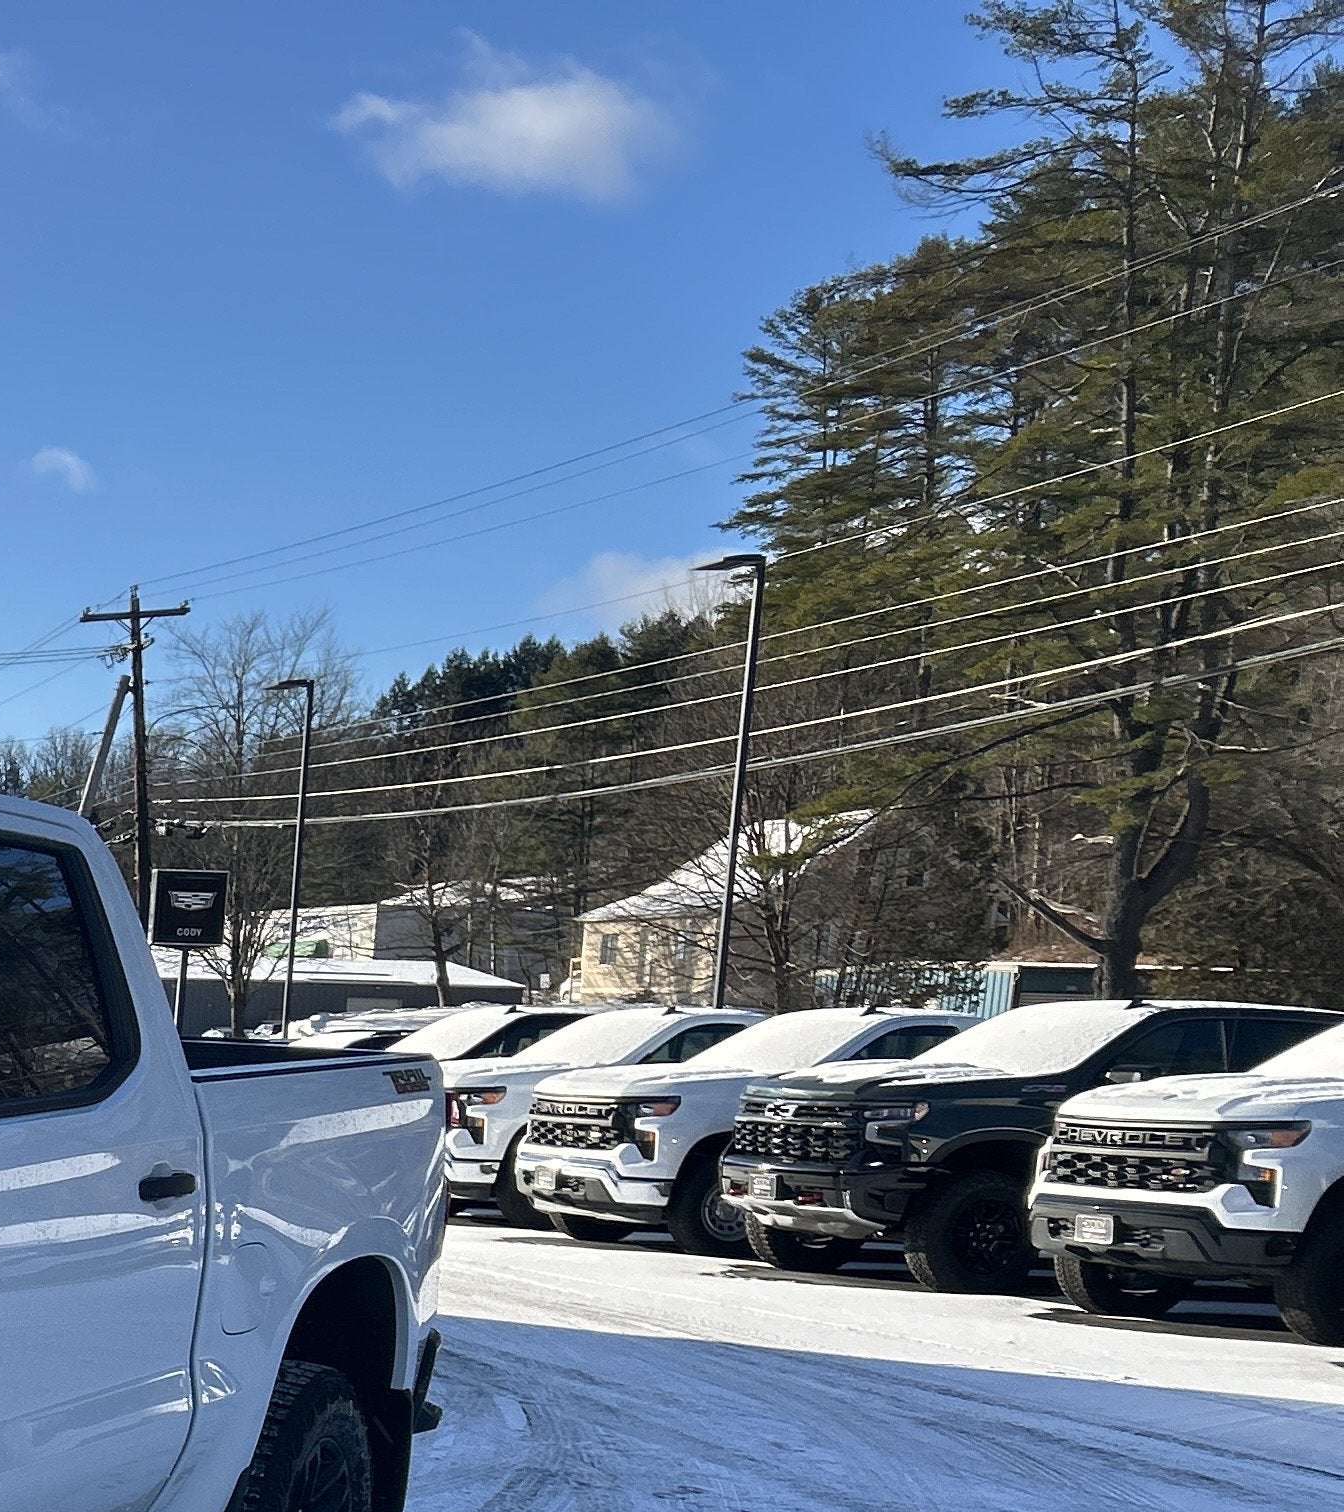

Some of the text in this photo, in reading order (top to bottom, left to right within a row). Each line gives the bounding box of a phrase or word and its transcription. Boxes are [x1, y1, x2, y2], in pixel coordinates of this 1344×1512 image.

[176, 927, 203, 937] CODY
[382, 1068, 432, 1084] TRAIL
[1055, 1125, 1210, 1151] CHEVROLET
